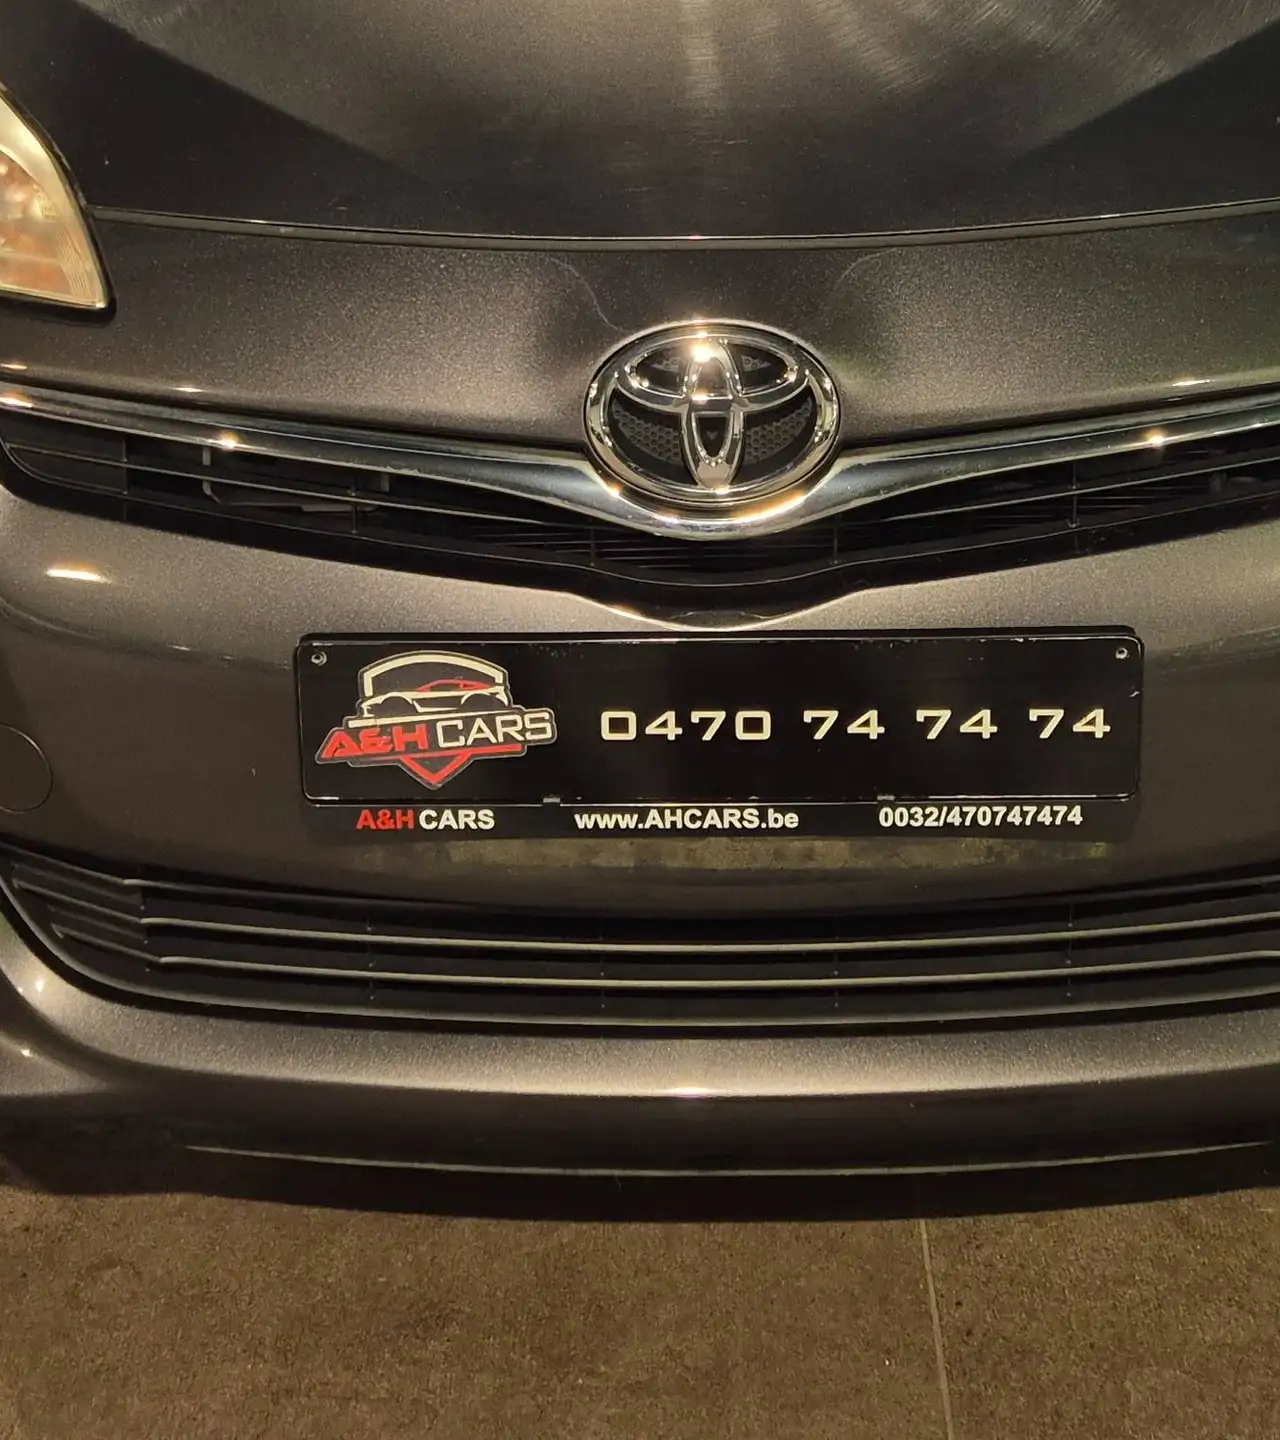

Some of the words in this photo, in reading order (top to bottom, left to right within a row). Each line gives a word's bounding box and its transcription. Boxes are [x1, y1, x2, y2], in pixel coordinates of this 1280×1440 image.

[321, 723, 429, 759] A&H
[435, 711, 553, 749] CARS
[600, 710, 771, 741] 0470
[803, 709, 885, 740] 74
[916, 708, 998, 740] 74
[1029, 708, 1111, 739] 74
[356, 809, 415, 830] A&H
[419, 809, 495, 830] CARS
[574, 808, 799, 830] www.AHCARS.be
[878, 805, 1084, 828] 0032/470747474
